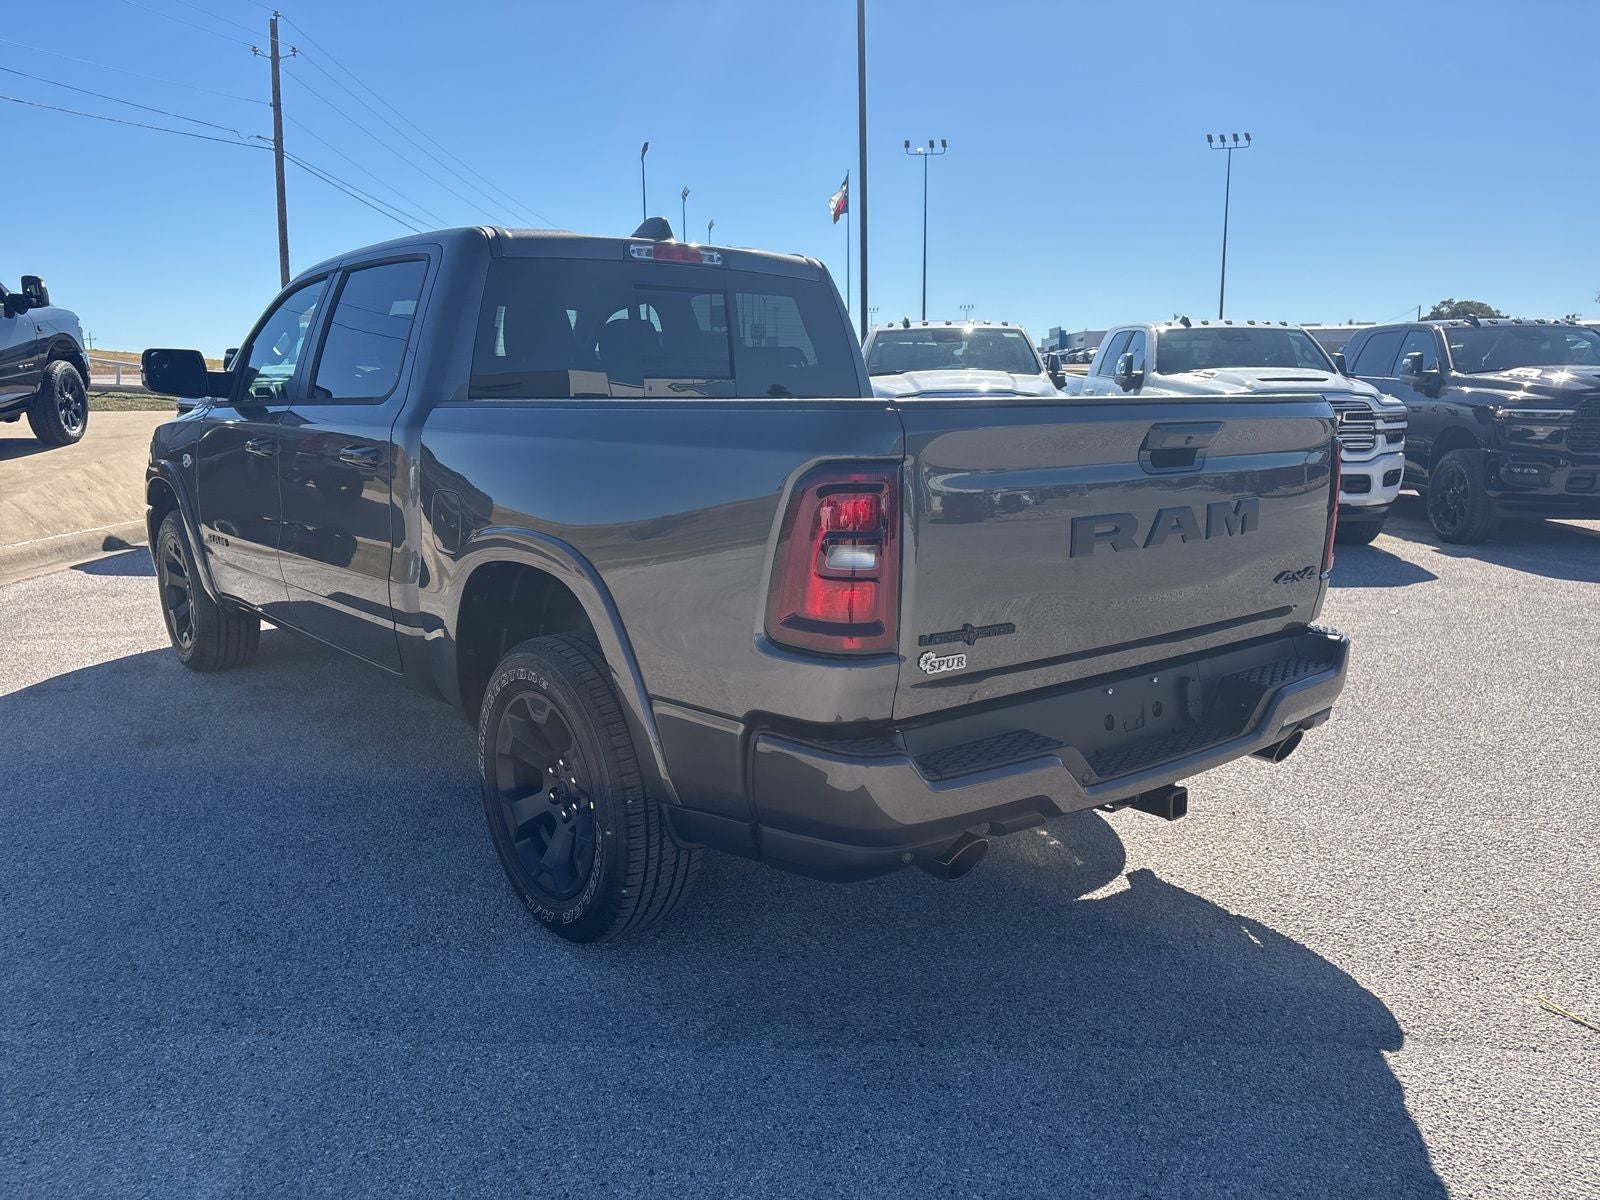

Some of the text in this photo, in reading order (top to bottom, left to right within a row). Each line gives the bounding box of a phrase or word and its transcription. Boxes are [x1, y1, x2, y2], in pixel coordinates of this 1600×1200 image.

[1070, 499, 1260, 558] RAM
[918, 628, 963, 647] LONE
[927, 655, 966, 673] SPUR
[478, 668, 550, 781] BRIDGESTONE
